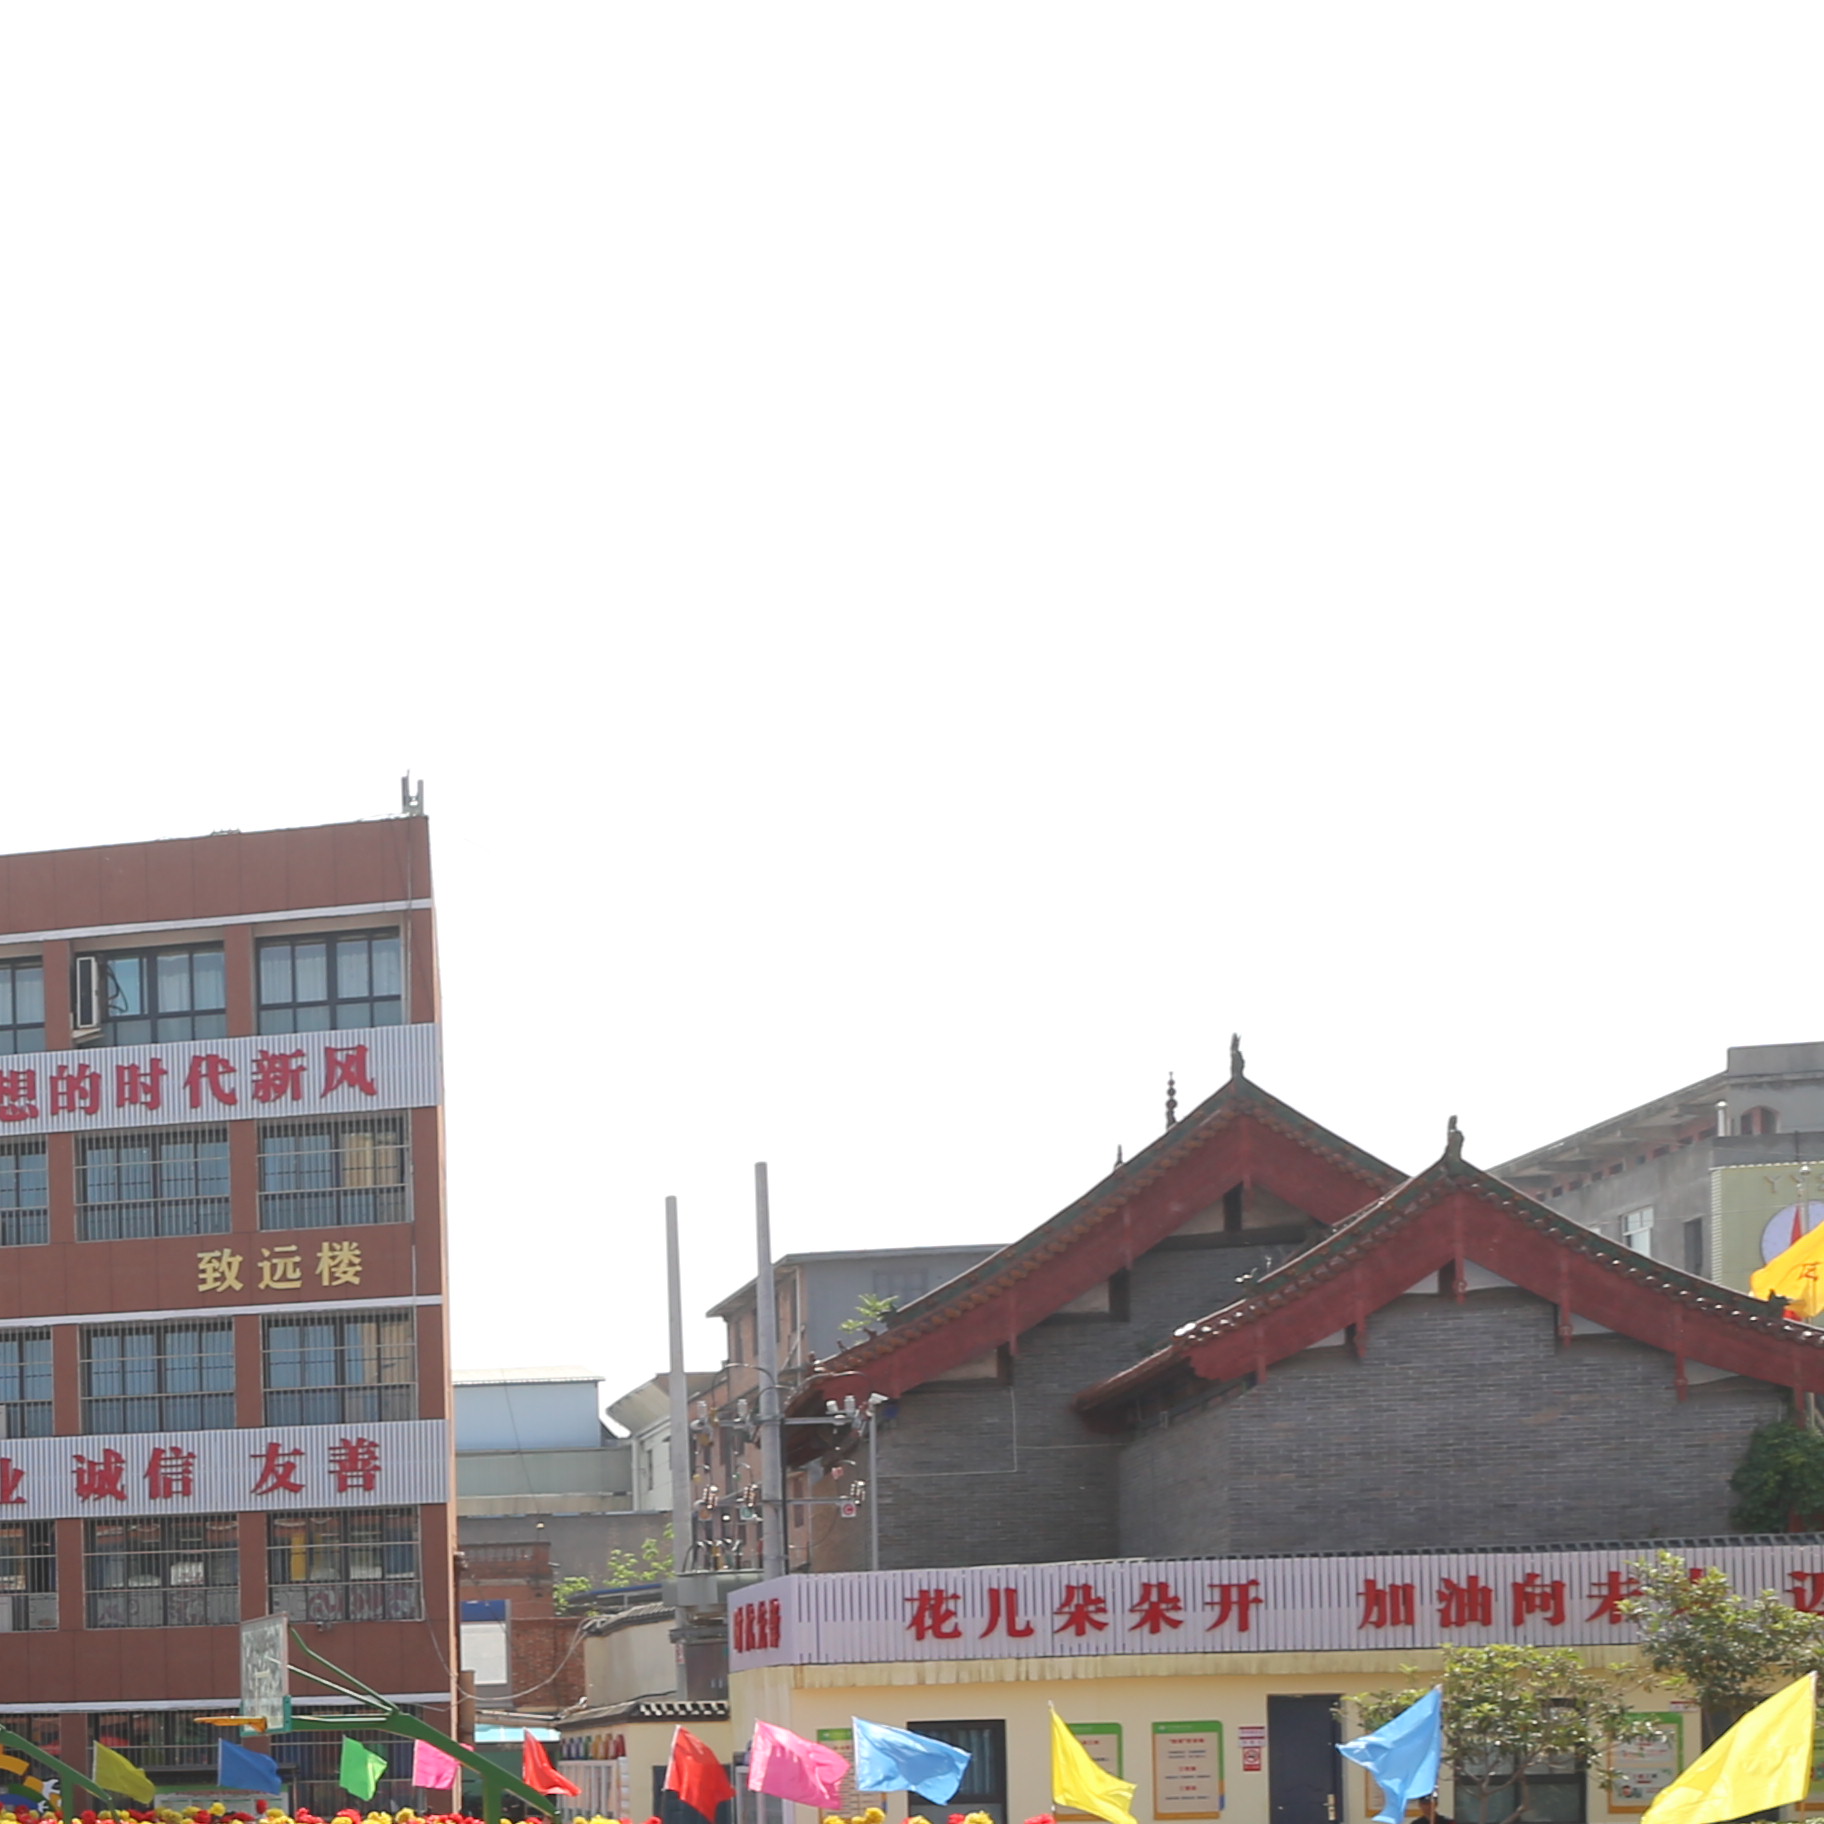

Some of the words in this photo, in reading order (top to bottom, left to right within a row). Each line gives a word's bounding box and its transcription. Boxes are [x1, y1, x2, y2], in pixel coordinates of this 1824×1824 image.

[196, 1240, 363, 1293] 致远楼
[72, 1446, 197, 1502] 诚信
[250, 1436, 383, 1496] 友善
[906, 1578, 1264, 1641] 花儿朵朵开
